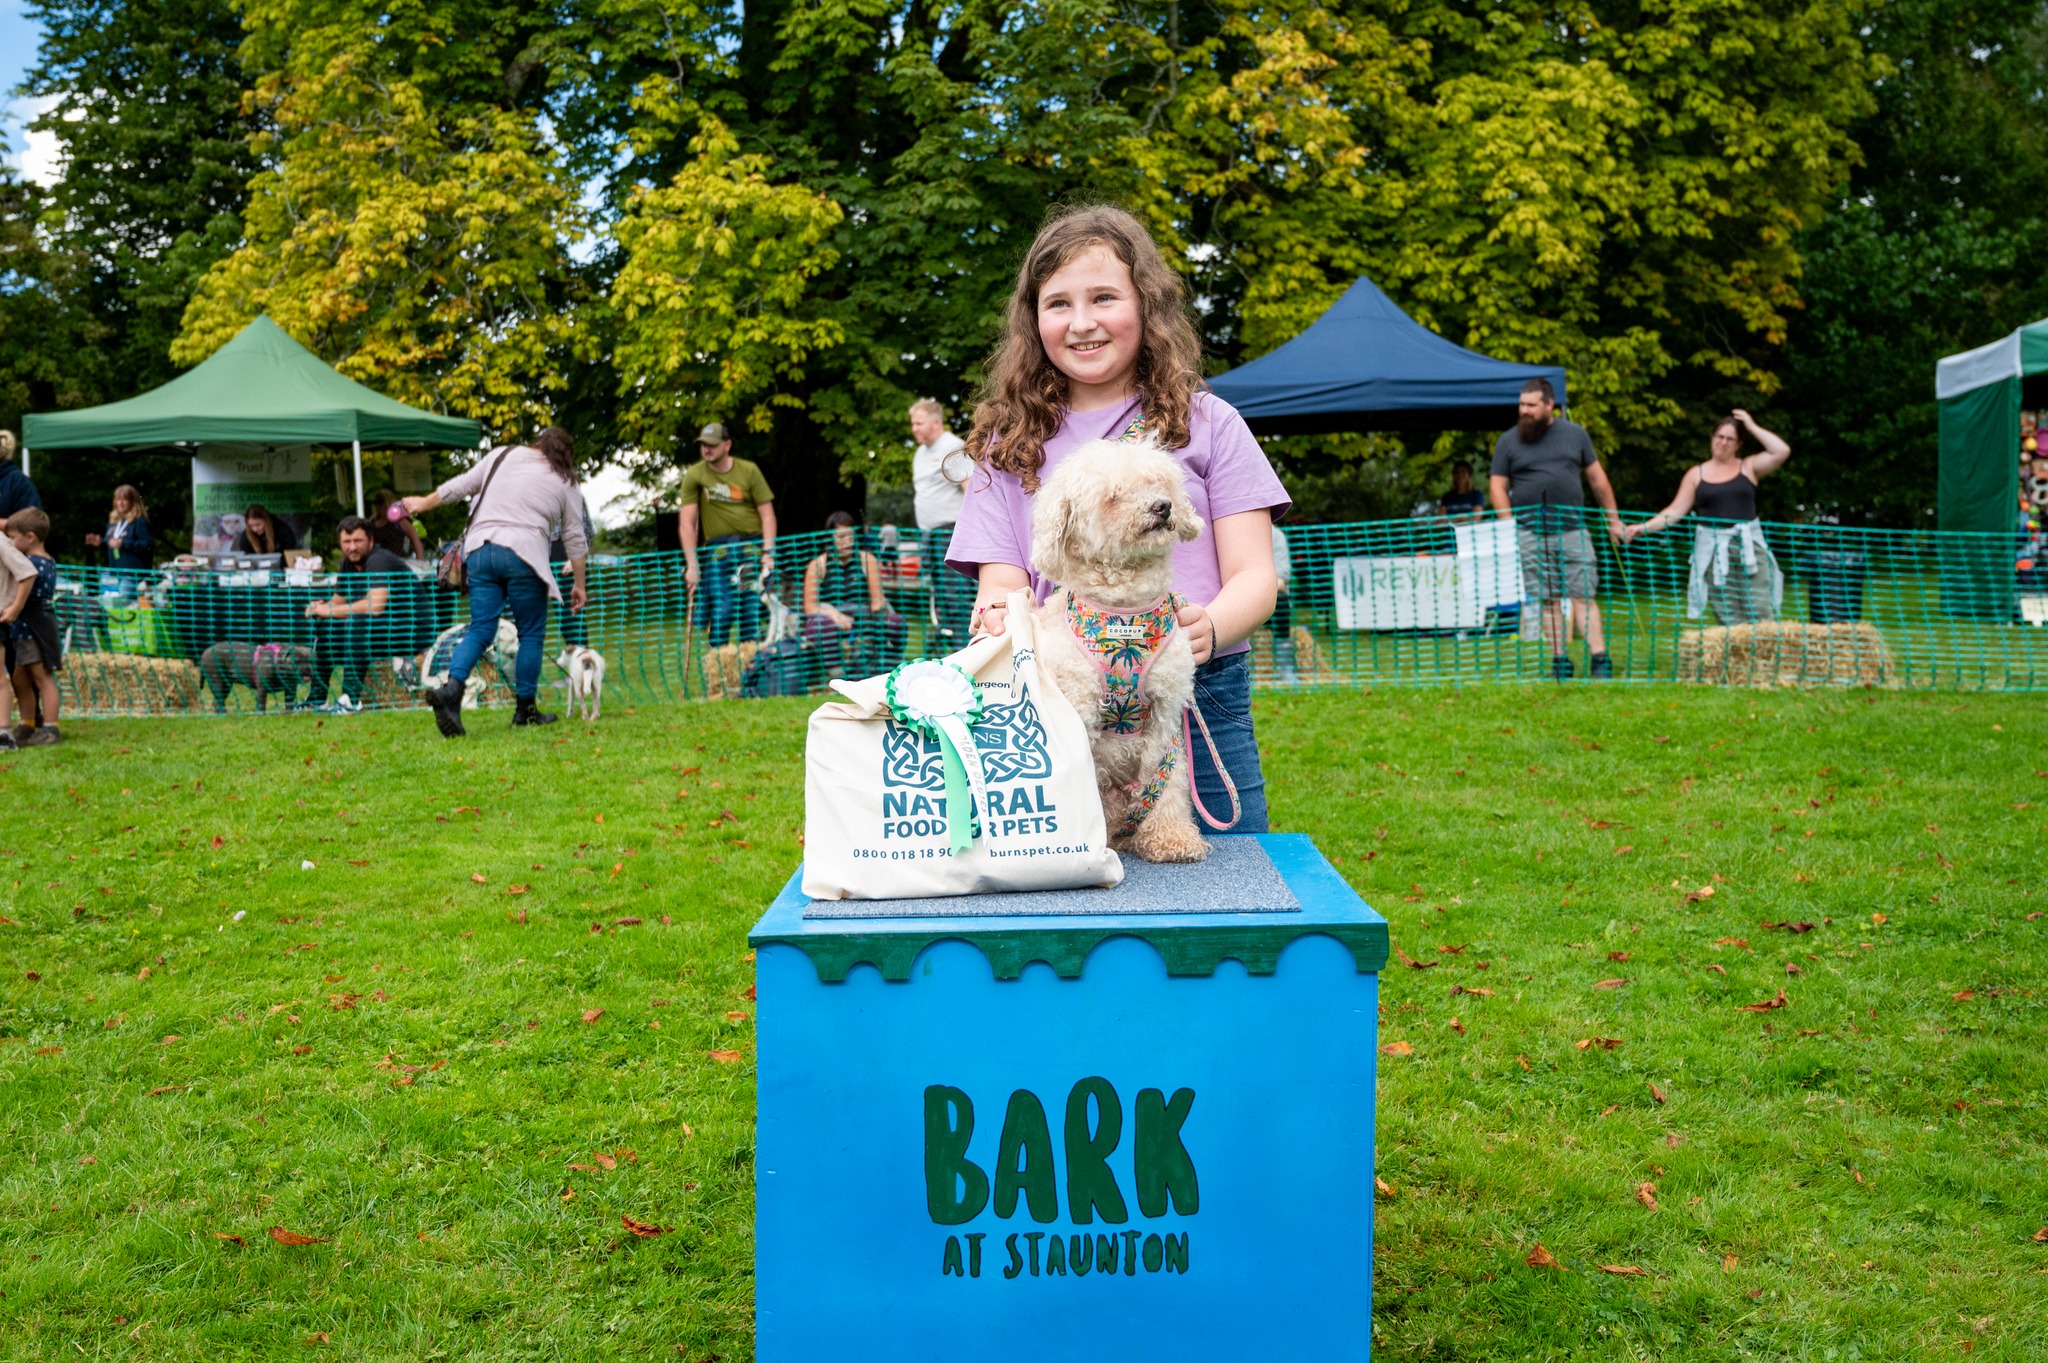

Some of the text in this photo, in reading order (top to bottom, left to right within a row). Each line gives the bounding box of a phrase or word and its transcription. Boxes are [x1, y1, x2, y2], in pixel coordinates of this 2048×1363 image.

[237, 462, 264, 473] Trust
[196, 503, 228, 512] HOMES
[974, 681, 1011, 689] urgeon
[958, 731, 978, 767] OLDEN
[884, 819, 947, 839] FOOD
[1003, 816, 1058, 837] PETS
[853, 848, 887, 859] 0800
[891, 850, 916, 860] 018
[919, 848, 934, 859] 18
[990, 843, 1090, 857] burnspet.co.uk
[924, 1076, 1199, 1225] BARK
[943, 1230, 1189, 1279] AT STAUNTON
